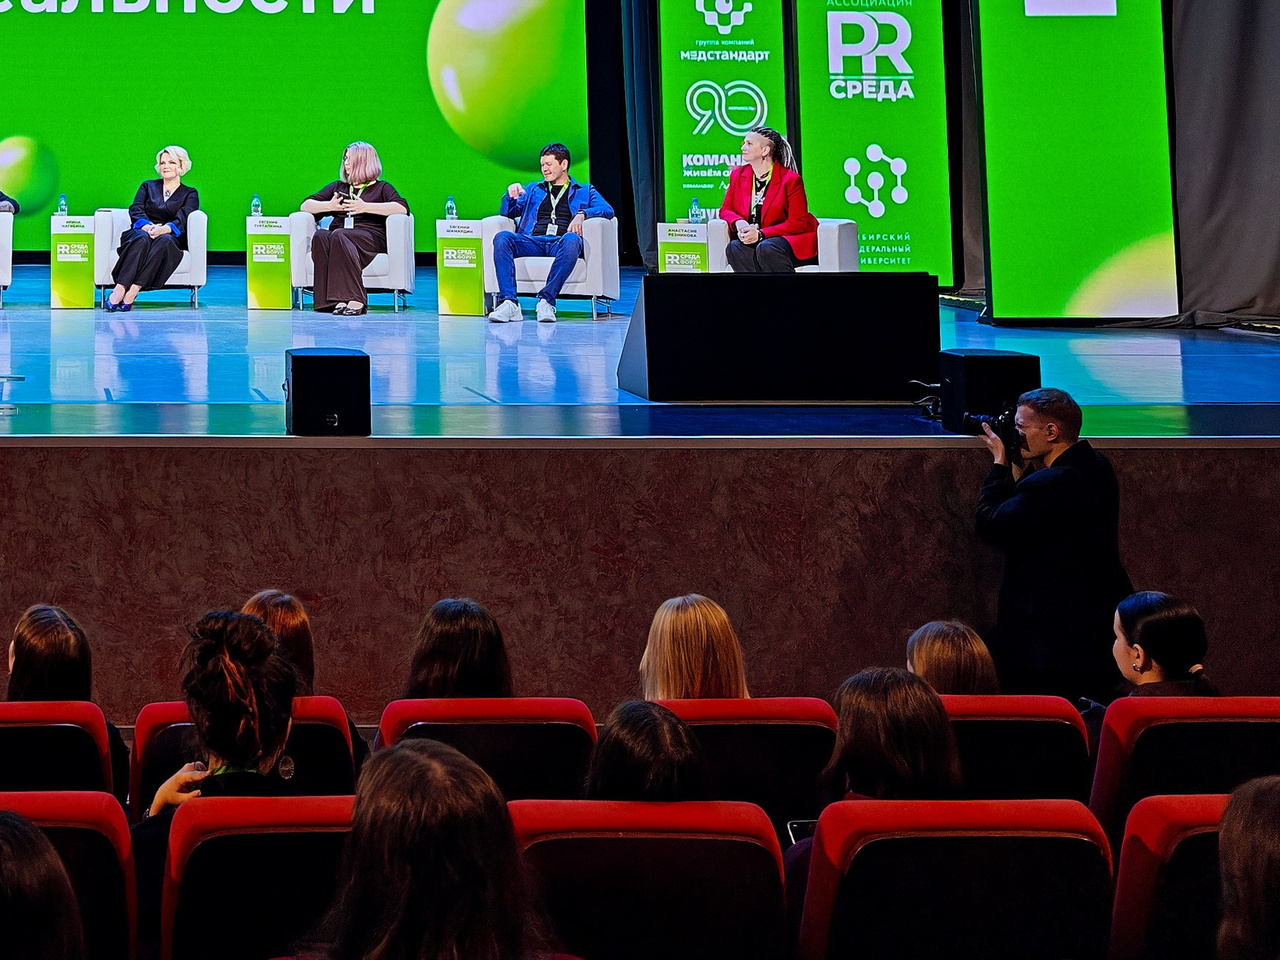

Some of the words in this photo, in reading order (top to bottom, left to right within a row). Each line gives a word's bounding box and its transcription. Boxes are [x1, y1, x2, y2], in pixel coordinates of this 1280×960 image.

[827, 11, 914, 74] PR
[829, 79, 915, 102] СРЕДА
[682, 154, 747, 167] КОМАН
[858, 232, 910, 241] БИРСКИЙ
[57, 244, 70, 254] PR
[252, 244, 266, 255] PR
[859, 244, 911, 253] ДЕРАЛЬНЫЙ
[443, 249, 457, 260] PR
[665, 254, 680, 265] PR
[861, 257, 911, 265] ИВЕРСИТЕТ
